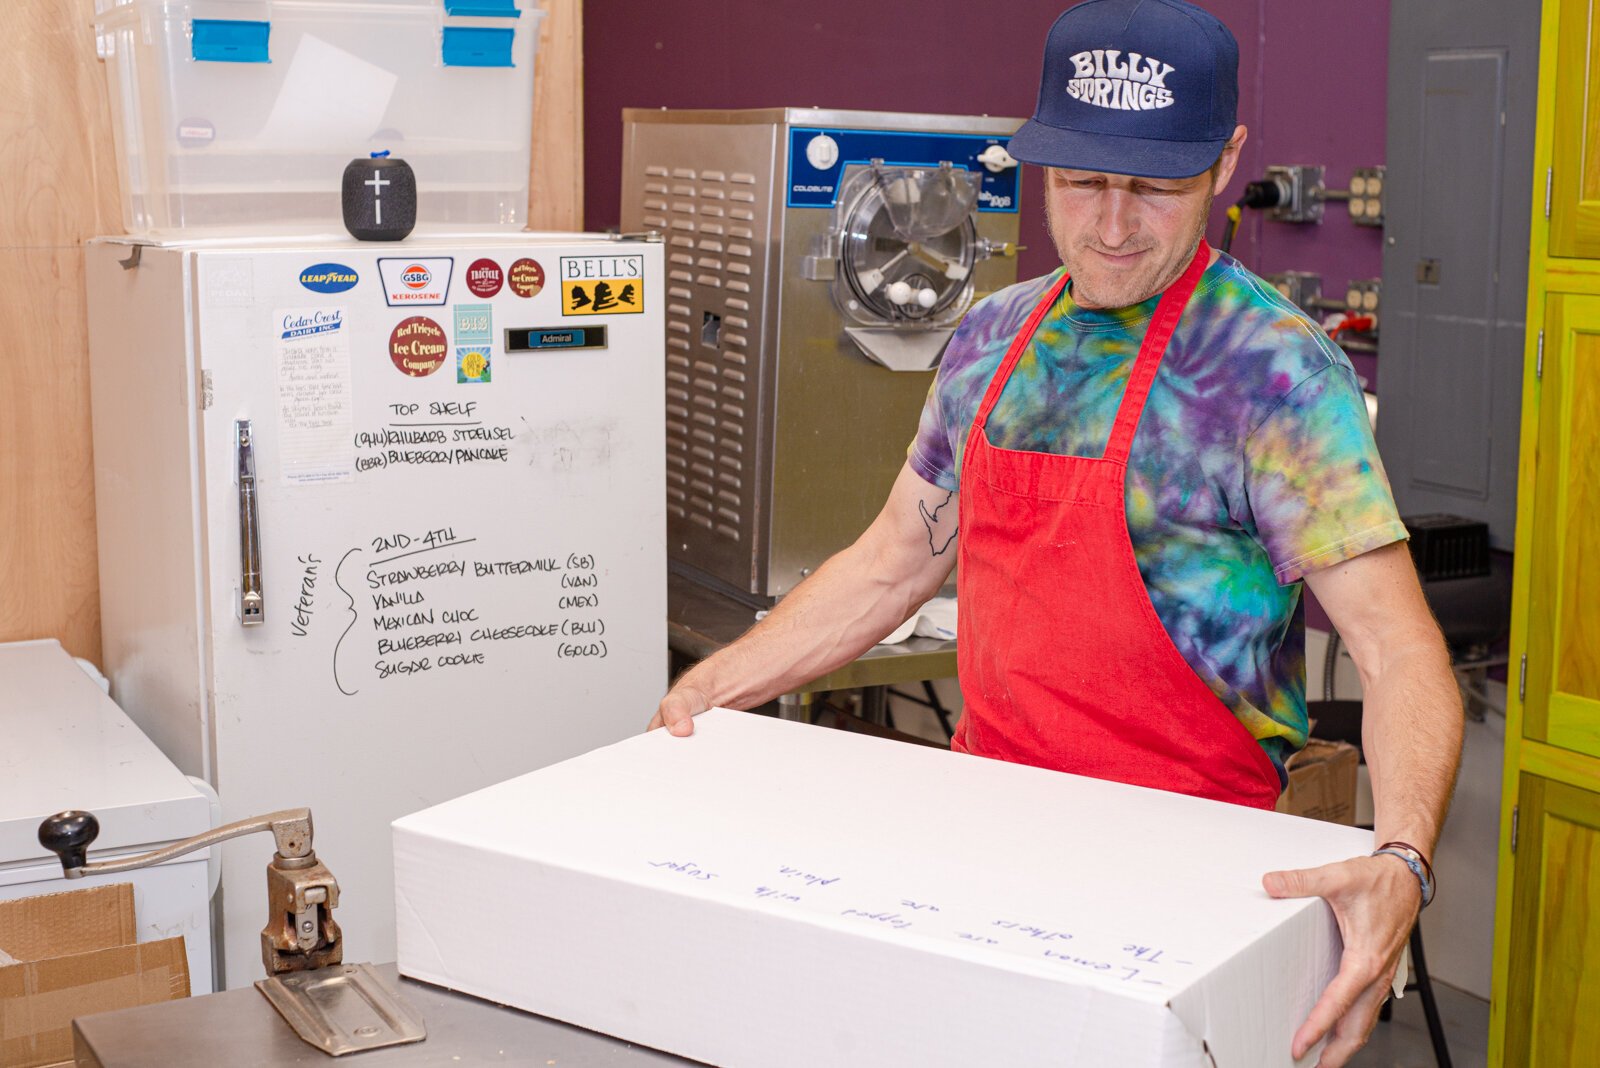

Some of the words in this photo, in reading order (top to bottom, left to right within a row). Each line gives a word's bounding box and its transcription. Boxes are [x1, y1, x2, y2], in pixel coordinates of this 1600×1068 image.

[1069, 50, 1175, 88] BILLY
[1066, 78, 1175, 111] STRINGS
[403, 273, 429, 282] GSBG
[568, 259, 638, 278] BELL'S
[283, 314, 313, 330] Cedar
[314, 310, 342, 324] Crest
[290, 327, 317, 337] DAIRY
[319, 323, 335, 332] INC.
[397, 324, 412, 337] Red
[412, 323, 441, 337] Tricycle
[393, 343, 410, 355] Ice
[411, 340, 445, 355] Cream
[541, 334, 572, 344] Admiral
[403, 358, 436, 372] Company
[389, 403, 419, 416] TOP
[429, 401, 477, 417] SHELF
[452, 427, 515, 442] STREUSEL
[366, 560, 466, 589] STRAWBERRY
[474, 558, 561, 577] BUTTERMILK
[566, 553, 595, 570] (SB)
[290, 553, 322, 638] Veteran's
[372, 591, 425, 610] VANILLA
[561, 573, 598, 589] (VAN)
[373, 608, 434, 631] MEXICAN
[442, 608, 479, 624] CHOC
[558, 593, 599, 609] (MEX)
[377, 631, 462, 656] BLUEBERRY
[561, 619, 605, 636] (BLU)
[375, 657, 432, 679] SUGAR
[438, 653, 485, 668] COOKIE
[557, 640, 608, 658] (GOLD)
[1122, 944, 1164, 964] The
